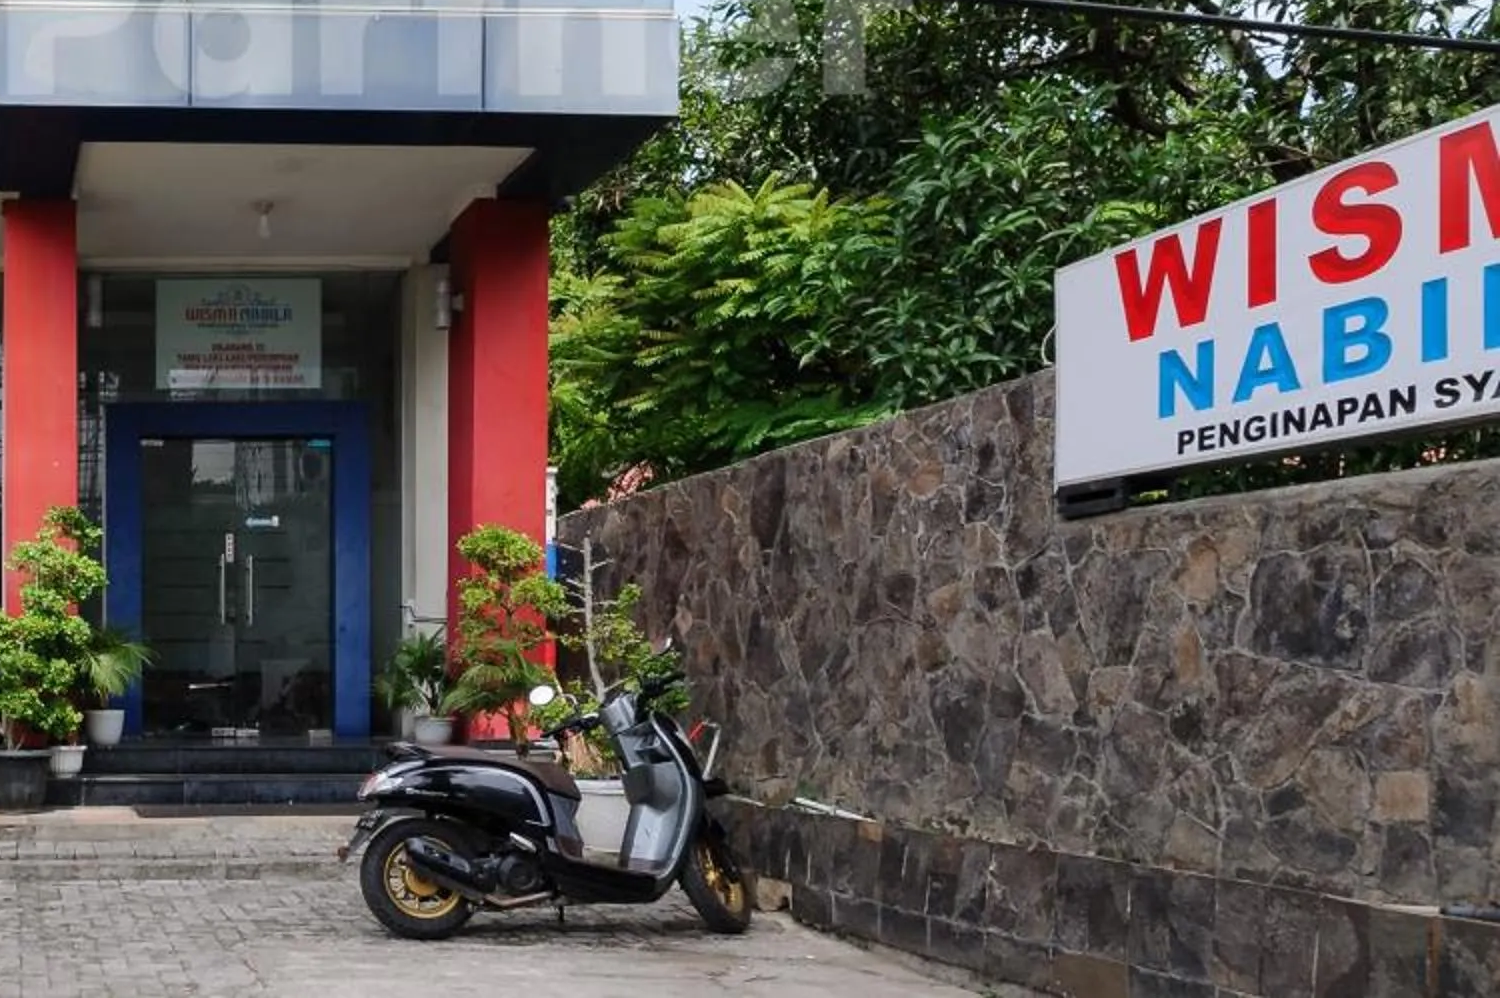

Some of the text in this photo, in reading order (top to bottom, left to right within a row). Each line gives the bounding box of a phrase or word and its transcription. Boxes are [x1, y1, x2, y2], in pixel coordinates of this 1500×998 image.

[1157, 262, 1500, 419] NABI
[1177, 369, 1500, 455] PENGINAPAN SY
